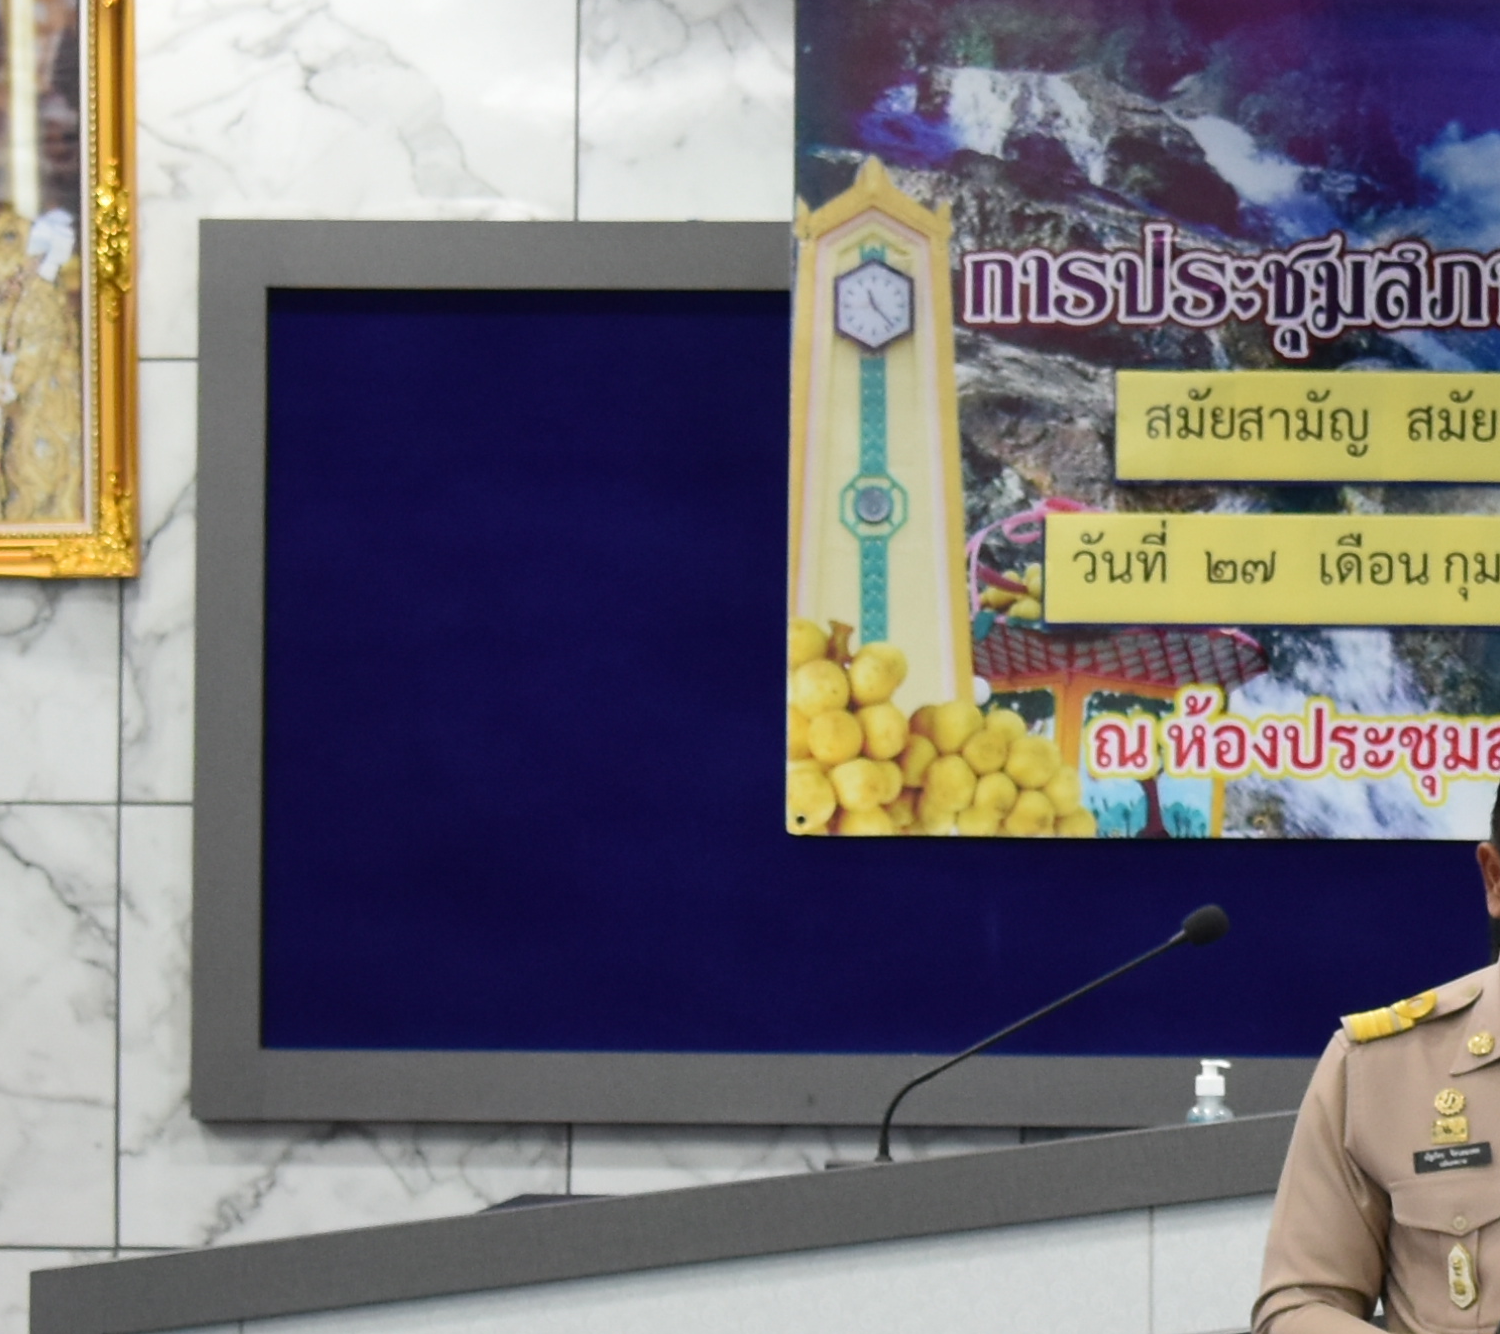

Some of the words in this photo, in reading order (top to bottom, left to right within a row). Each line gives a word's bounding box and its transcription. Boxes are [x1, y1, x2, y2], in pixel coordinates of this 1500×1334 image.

[1145, 388, 1370, 458] สมัยสามัญ
[1073, 520, 1168, 585] วันที่
[1205, 549, 1277, 585] ๒๗
[1320, 533, 1430, 586] เดือน
